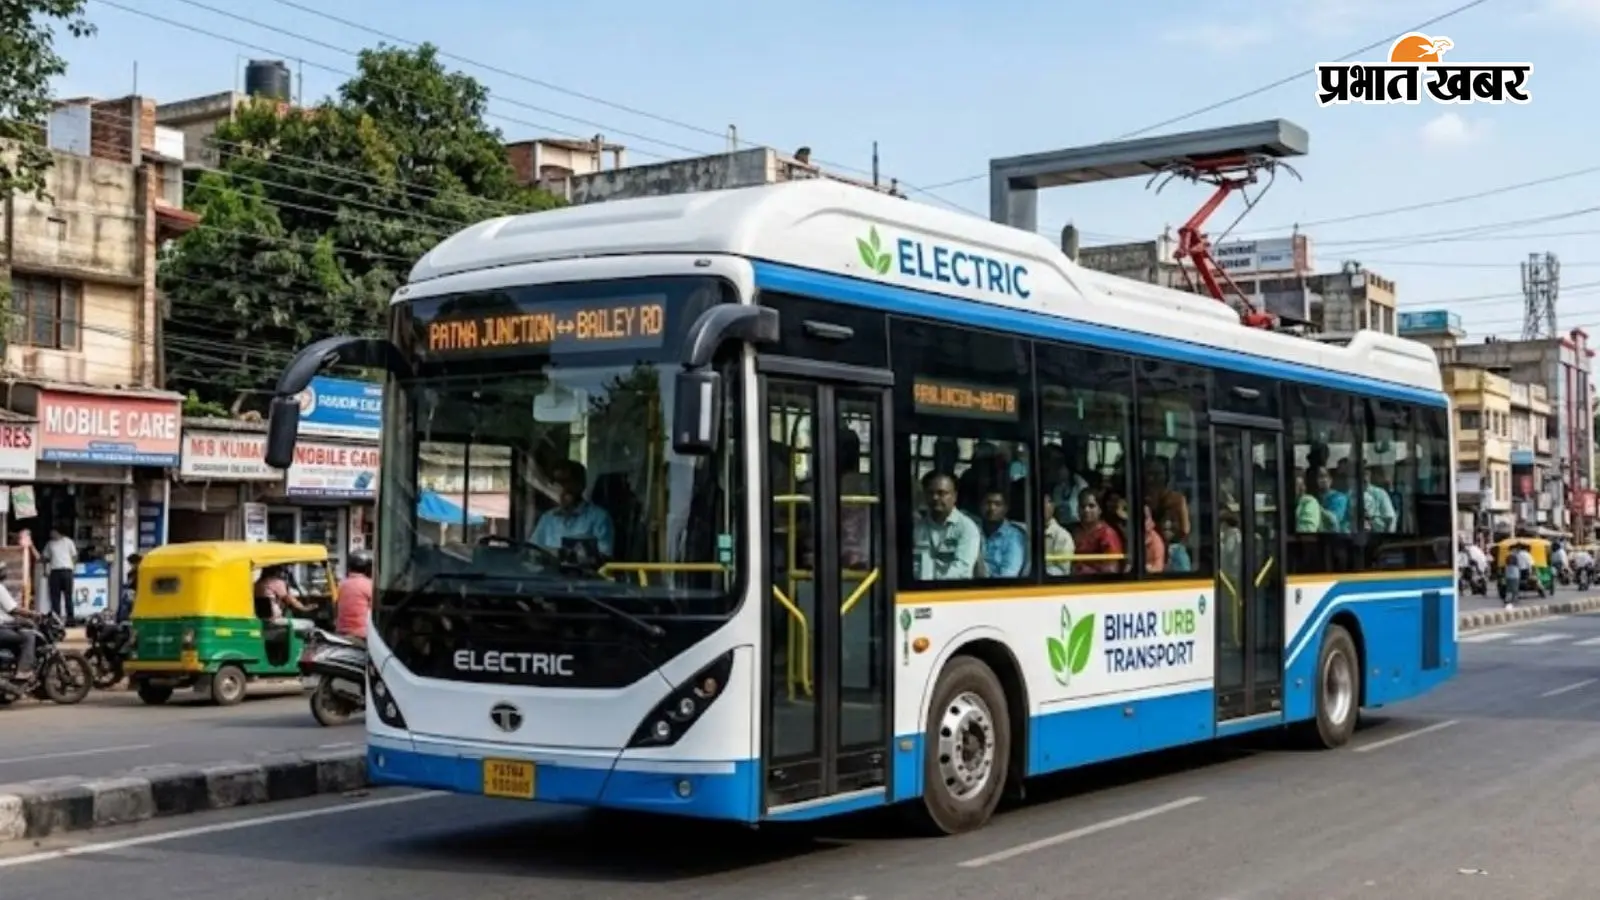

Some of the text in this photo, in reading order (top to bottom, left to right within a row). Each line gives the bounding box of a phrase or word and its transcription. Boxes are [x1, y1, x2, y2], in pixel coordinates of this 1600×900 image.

[897, 238, 1031, 299] ELECTRIC
[640, 304, 664, 335] RD
[0, 426, 32, 449] RES
[45, 405, 176, 440] MOBILE CARE
[1104, 609, 1195, 642] BIHAR URB
[453, 650, 574, 676] ELECTRIC
[1104, 640, 1195, 674] TRANSPORT
